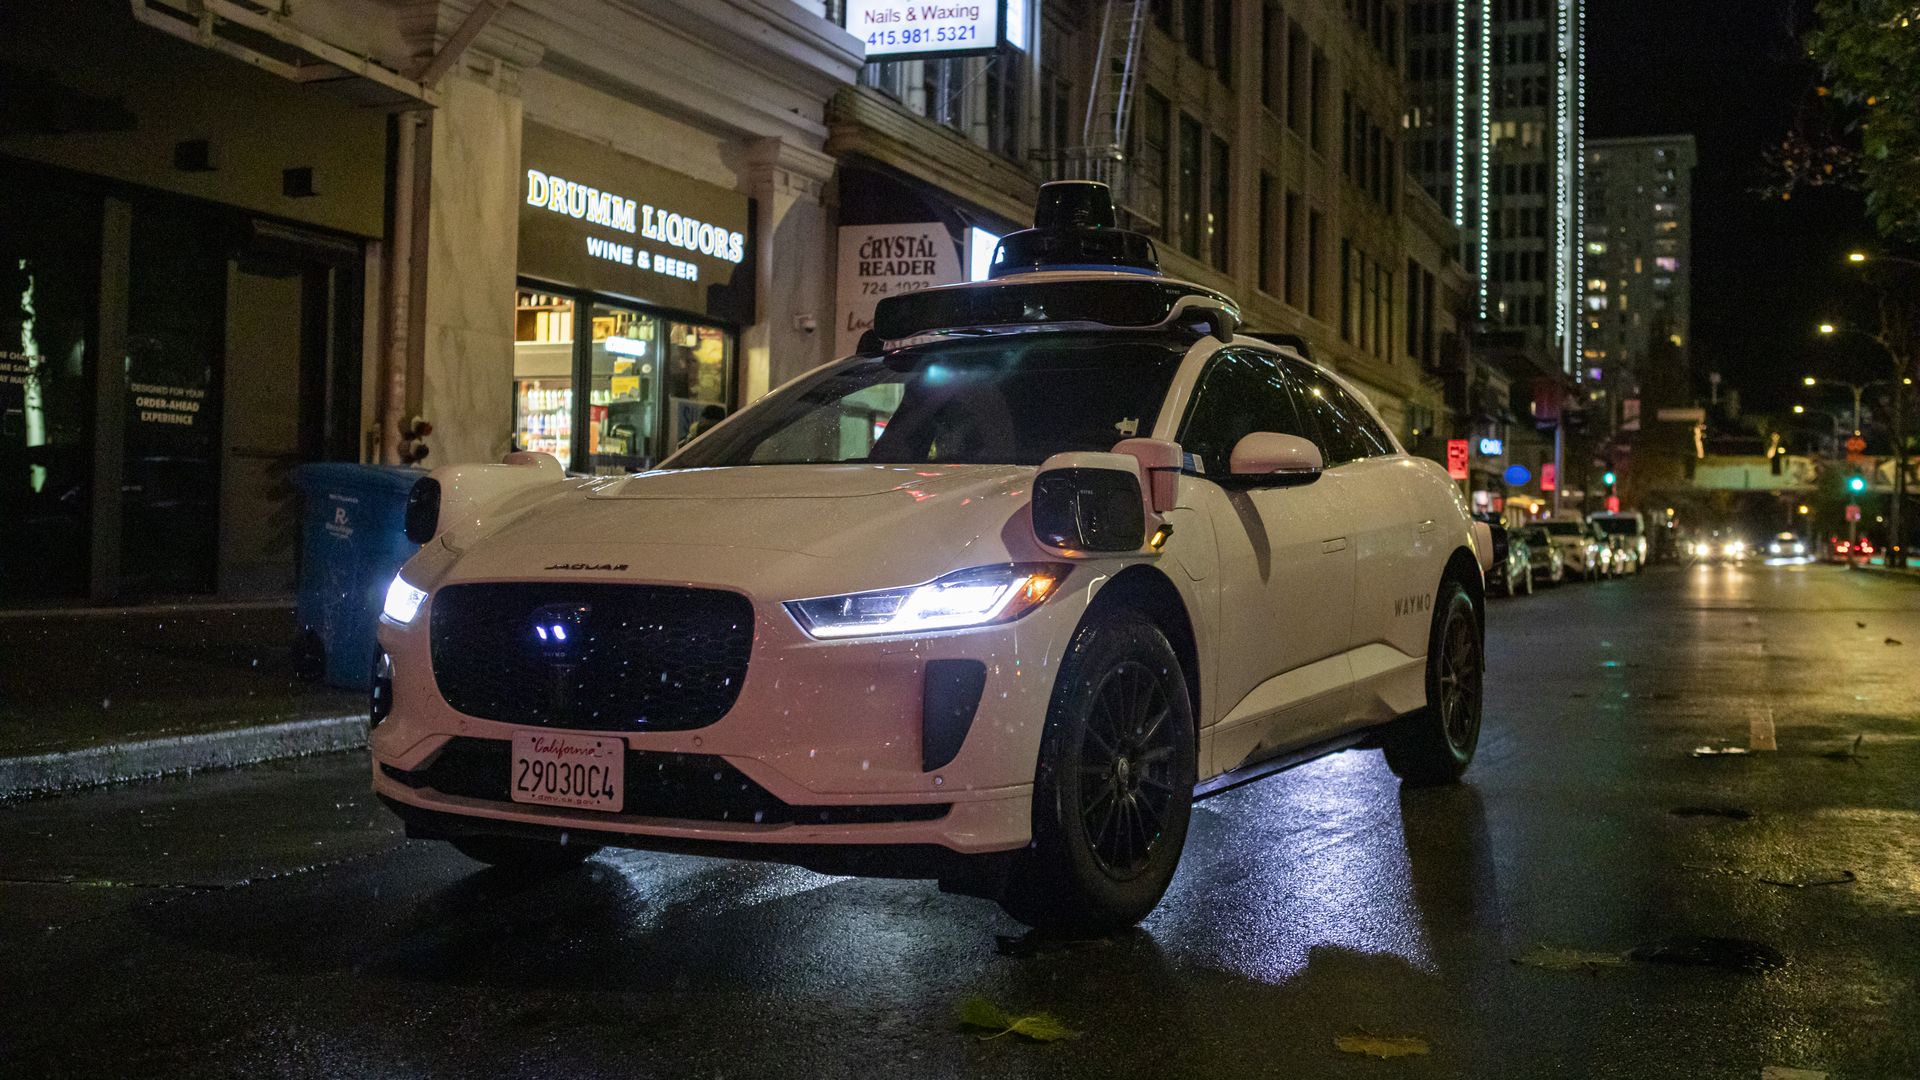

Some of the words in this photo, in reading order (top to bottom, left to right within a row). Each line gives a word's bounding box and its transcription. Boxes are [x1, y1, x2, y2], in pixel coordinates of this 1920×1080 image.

[864, 9, 901, 24] Nails
[906, 7, 917, 21] &
[921, 5, 980, 20] Waxing
[868, 26, 976, 45] 415.981.5321
[527, 169, 636, 234] DRUMM
[641, 204, 745, 264] LIQUORS
[859, 234, 937, 259] CRYSTAL
[586, 236, 634, 266] WINE
[637, 250, 651, 270] &
[653, 254, 699, 282] BEER
[859, 260, 936, 276] READER
[135, 396, 200, 412] ORDER-AHEAD
[141, 411, 193, 425] EXPERIENCE
[544, 563, 629, 571] JAGUAR
[1394, 593, 1431, 617] WAYMO
[535, 736, 596, 759] California
[517, 759, 614, 799] 29030C4
